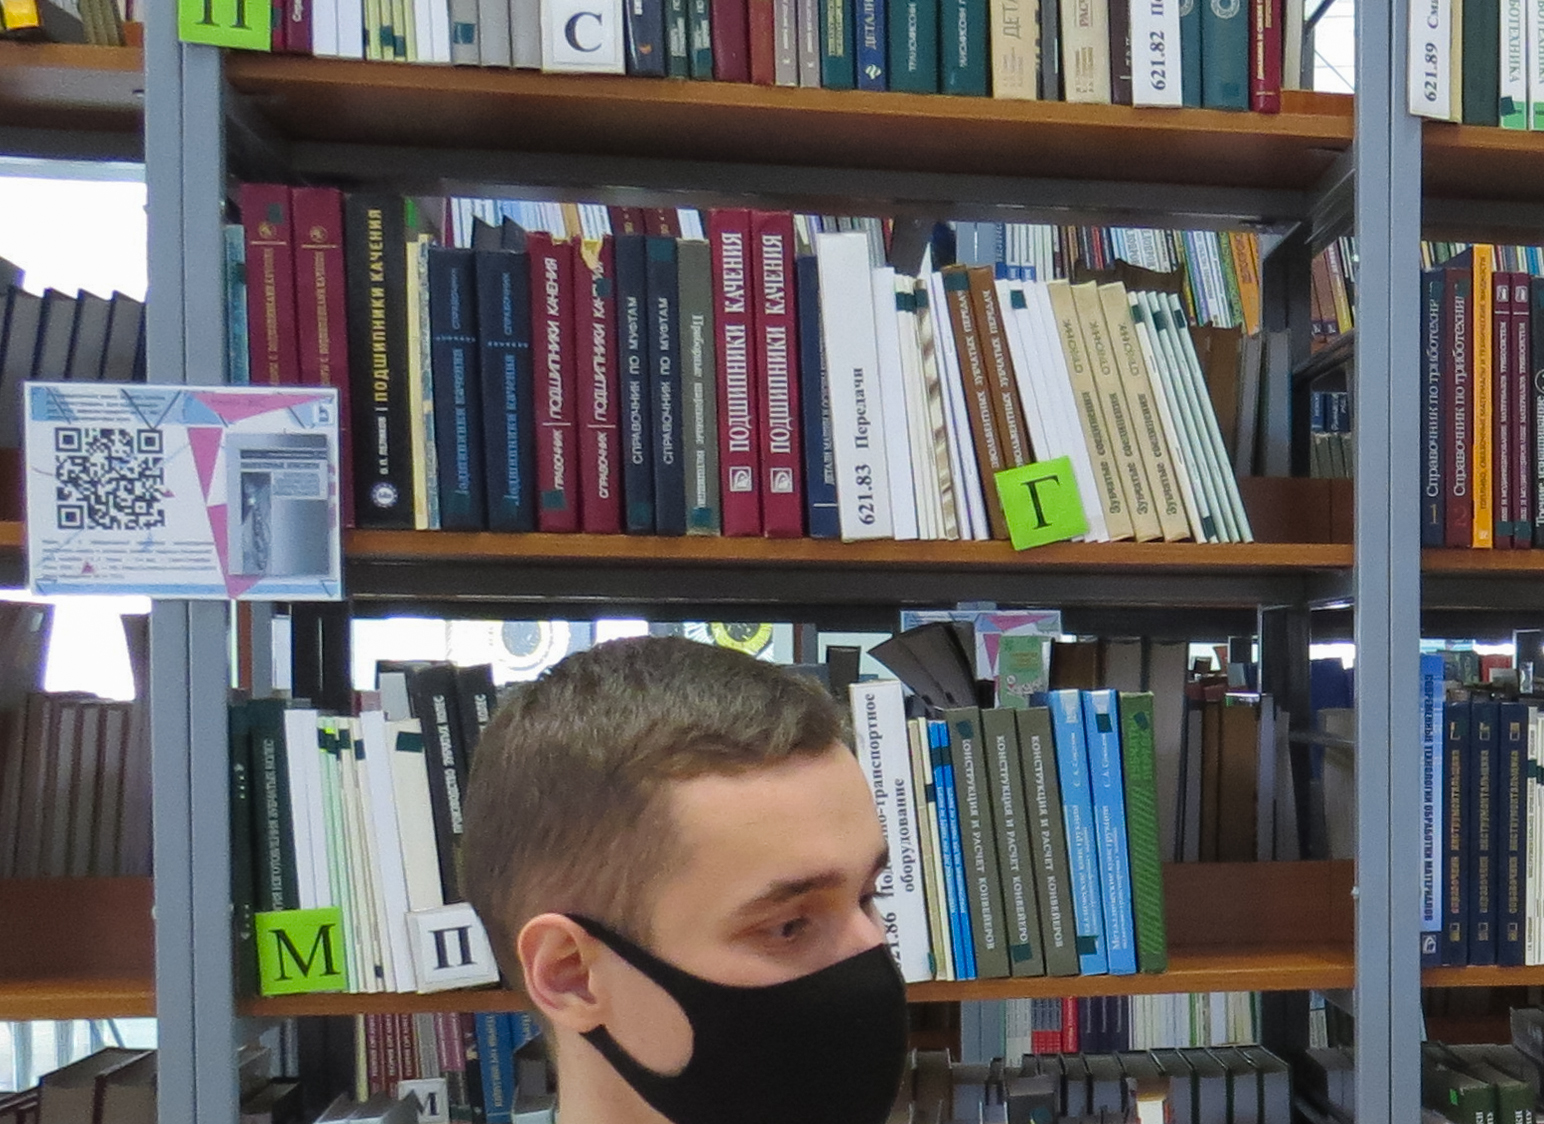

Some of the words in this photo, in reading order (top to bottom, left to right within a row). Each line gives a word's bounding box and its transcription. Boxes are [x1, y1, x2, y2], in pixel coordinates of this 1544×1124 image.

[564, 11, 602, 53] С
[1150, 31, 1166, 90] 621.82
[1424, 43, 1438, 102] 621.89
[368, 209, 383, 281] КАЧЕНИЯ
[721, 232, 746, 313] КАЧЕНИЯ
[762, 234, 786, 315] КАЧЕНИЯ
[544, 257, 561, 316] КАЧЕНИЯ
[983, 289, 998, 334] ПЕРЕДАЧ
[372, 287, 389, 402] ПОДШИПНИКИ
[627, 296, 639, 350] МУФТАМ
[658, 297, 670, 350] МУФТАМ
[544, 321, 563, 419] ПОДШИПНИКИ
[592, 324, 609, 422] ПОДШИПНИКИ
[629, 356, 640, 374] ПО
[660, 357, 671, 375] ПО
[725, 325, 752, 452] ПОДШИПНИКИ
[765, 327, 793, 454] ПОДШИПНИКИ
[965, 336, 984, 386] ЗУБЧАТЫХ
[992, 337, 1009, 387] ЗУБЧАТЫХ
[629, 381, 644, 464] СПРАВОЧНИК
[661, 382, 675, 464] СПРАВОЧНИК
[853, 367, 870, 448] Передачи
[1428, 386, 1439, 404] по
[1455, 387, 1466, 404] по
[1425, 407, 1440, 497] Справочник
[1453, 406, 1467, 496] Справочник
[855, 464, 875, 525] 621.83
[1024, 474, 1060, 531] Г
[1099, 461, 1121, 514] Зубчатые
[1126, 462, 1149, 515] Зубчатые
[1155, 463, 1177, 515] Зубчатые
[433, 695, 447, 723] КОЛЕС
[996, 736, 1013, 816] КОНСТРУКЦИЯ
[1006, 831, 1019, 870] РАСЧЕТ
[1030, 736, 1048, 815] КОНСТРУКЦИЯ
[1424, 745, 1435, 804] ТЕХНОЛОГИИ
[894, 778, 916, 892] оборудование
[971, 820, 980, 828] И
[972, 832, 985, 872] РАСЧЕТ
[1041, 831, 1053, 870] РАСЧЕТ
[1424, 805, 1435, 859] ОБРАБОТКИ
[978, 877, 995, 950] КОНВЕЙЕРОВ
[1046, 876, 1064, 947] КОНВЕЙЕРОВ
[1424, 861, 1435, 921] МАТЕРИАЛОВ
[271, 923, 341, 982] М
[428, 925, 476, 971] П
